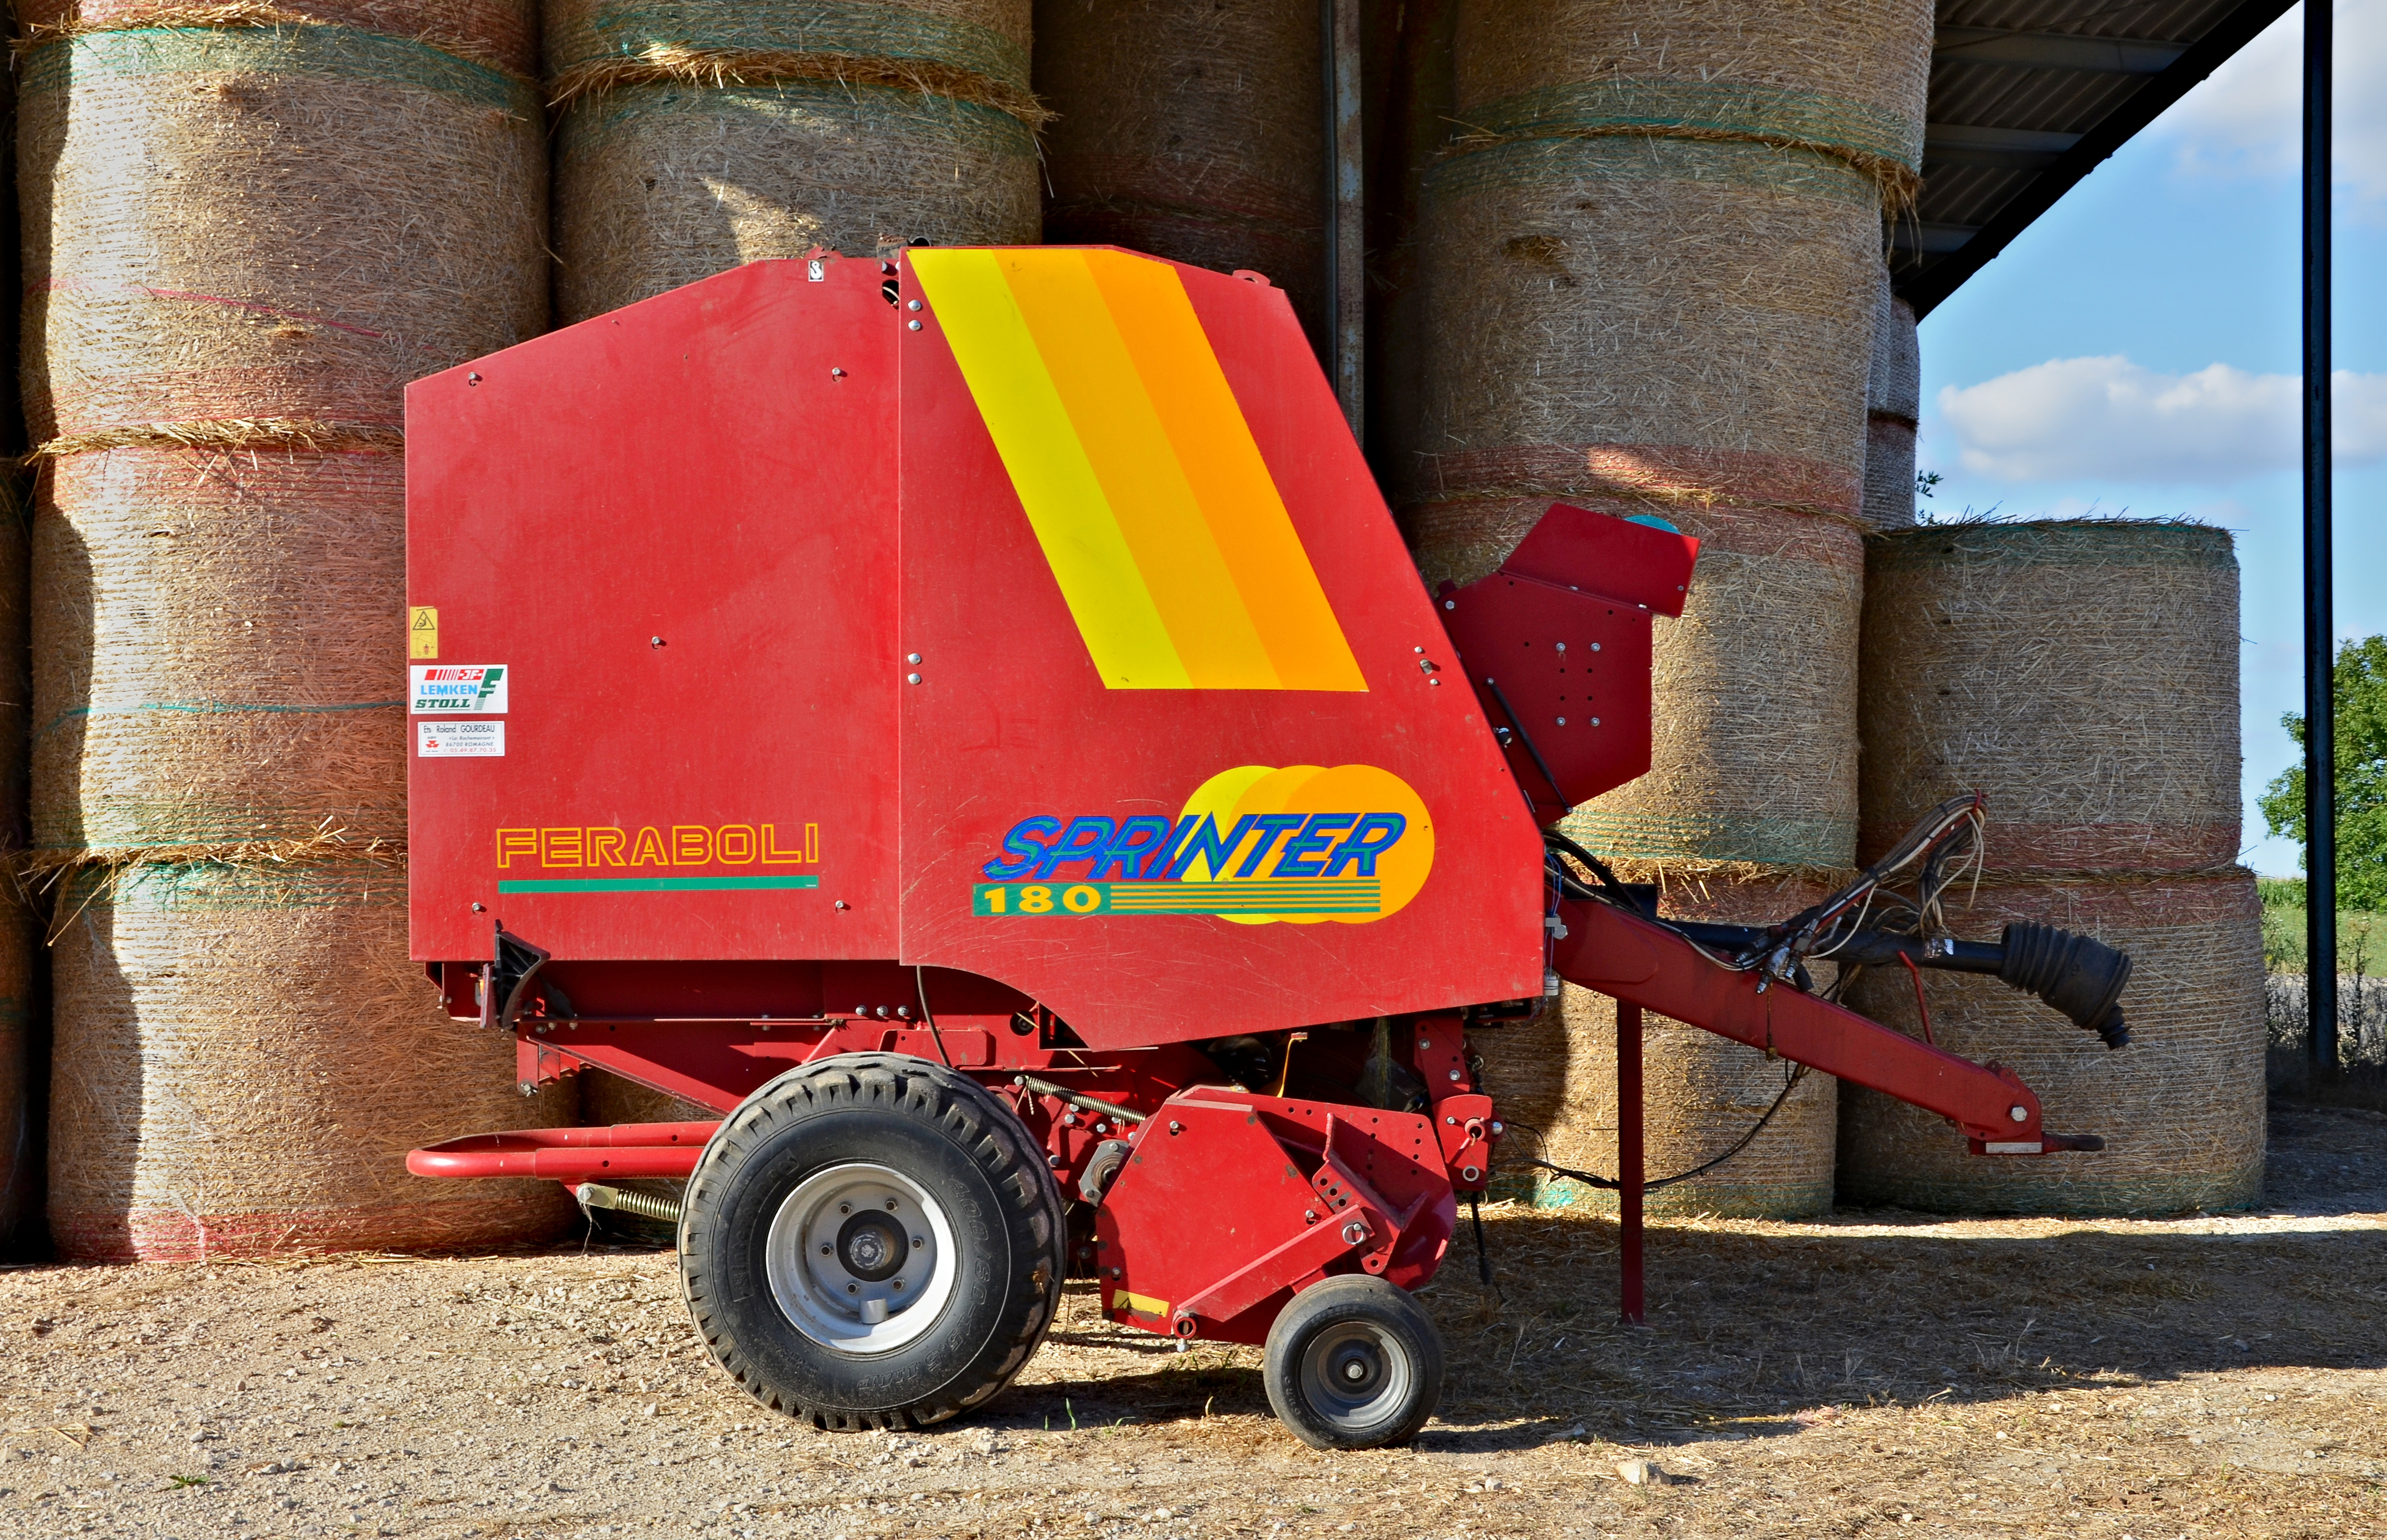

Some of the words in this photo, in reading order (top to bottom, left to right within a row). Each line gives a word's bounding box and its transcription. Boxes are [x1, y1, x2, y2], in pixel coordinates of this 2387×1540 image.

[415, 699, 471, 708] STOLL
[421, 684, 477, 696] LEMKEN
[436, 724, 456, 733] Roland
[496, 823, 819, 868] FERABOLI
[982, 810, 1407, 882] SPRINTER
[985, 885, 1101, 913] 180
[925, 1178, 991, 1372] 400/60-15.5
[857, 1361, 920, 1389] IMP
